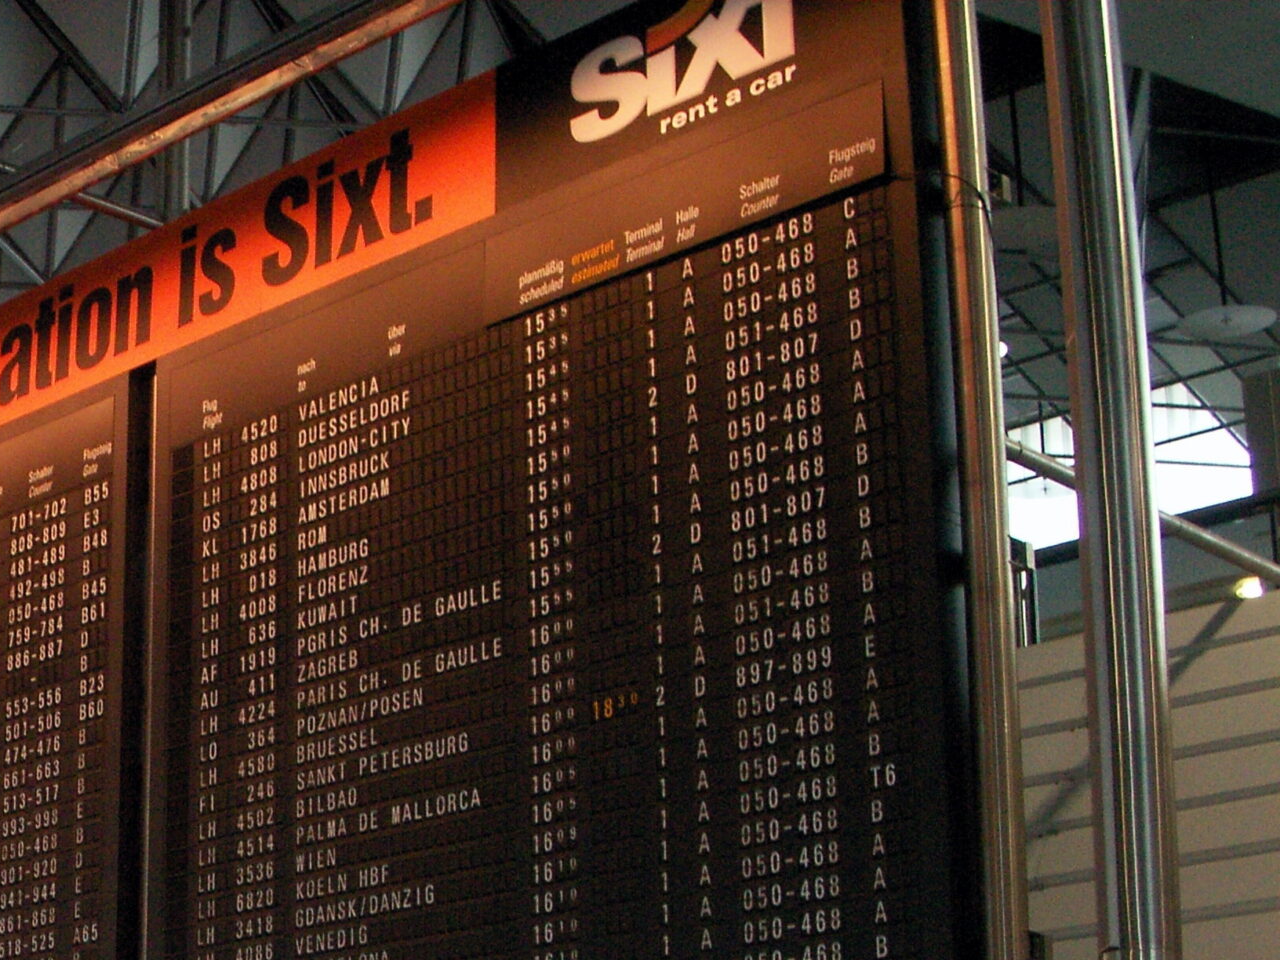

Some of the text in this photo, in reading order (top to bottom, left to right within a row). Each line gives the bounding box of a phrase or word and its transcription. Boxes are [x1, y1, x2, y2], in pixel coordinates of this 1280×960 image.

[660, 64, 797, 134] rent a car
[829, 137, 876, 165] Flugsteig
[739, 174, 781, 199] Schalter
[740, 194, 780, 218] Counter
[178, 225, 236, 328] is
[261, 128, 433, 287] Sixt.
[624, 217, 663, 245] Terminal
[571, 239, 615, 266] erwartet
[299, 376, 379, 421] VALENCIA
[298, 390, 411, 448] DUESSELDORF
[298, 417, 412, 473] LONDON-CITY
[300, 451, 390, 498] INNSBRUCK
[298, 477, 391, 524] AMSTERDAM
[298, 526, 328, 551] ROM
[298, 538, 369, 577] HAMBURG
[298, 566, 369, 603] FLORENZ
[297, 595, 358, 630] KUWAIT
[359, 616, 388, 638] CH.
[402, 604, 422, 625] DE
[435, 580, 502, 616] GAULLE
[297, 650, 358, 683] ZAGREB
[297, 637, 502, 709] PARIS CH. DE GAULLE
[297, 688, 424, 737] POZNAN/POSEN
[297, 728, 378, 764] BRUESSEL
[297, 732, 469, 791] SANKT PETERSBURG
[296, 787, 358, 818] BILBAO
[296, 787, 482, 845] PALMA DE MALLORCA
[296, 849, 337, 873] WIEN
[296, 865, 391, 900] KOELN HBF
[295, 884, 436, 928] GDANSK/DANZIG
[295, 926, 369, 955] VENEDIG
